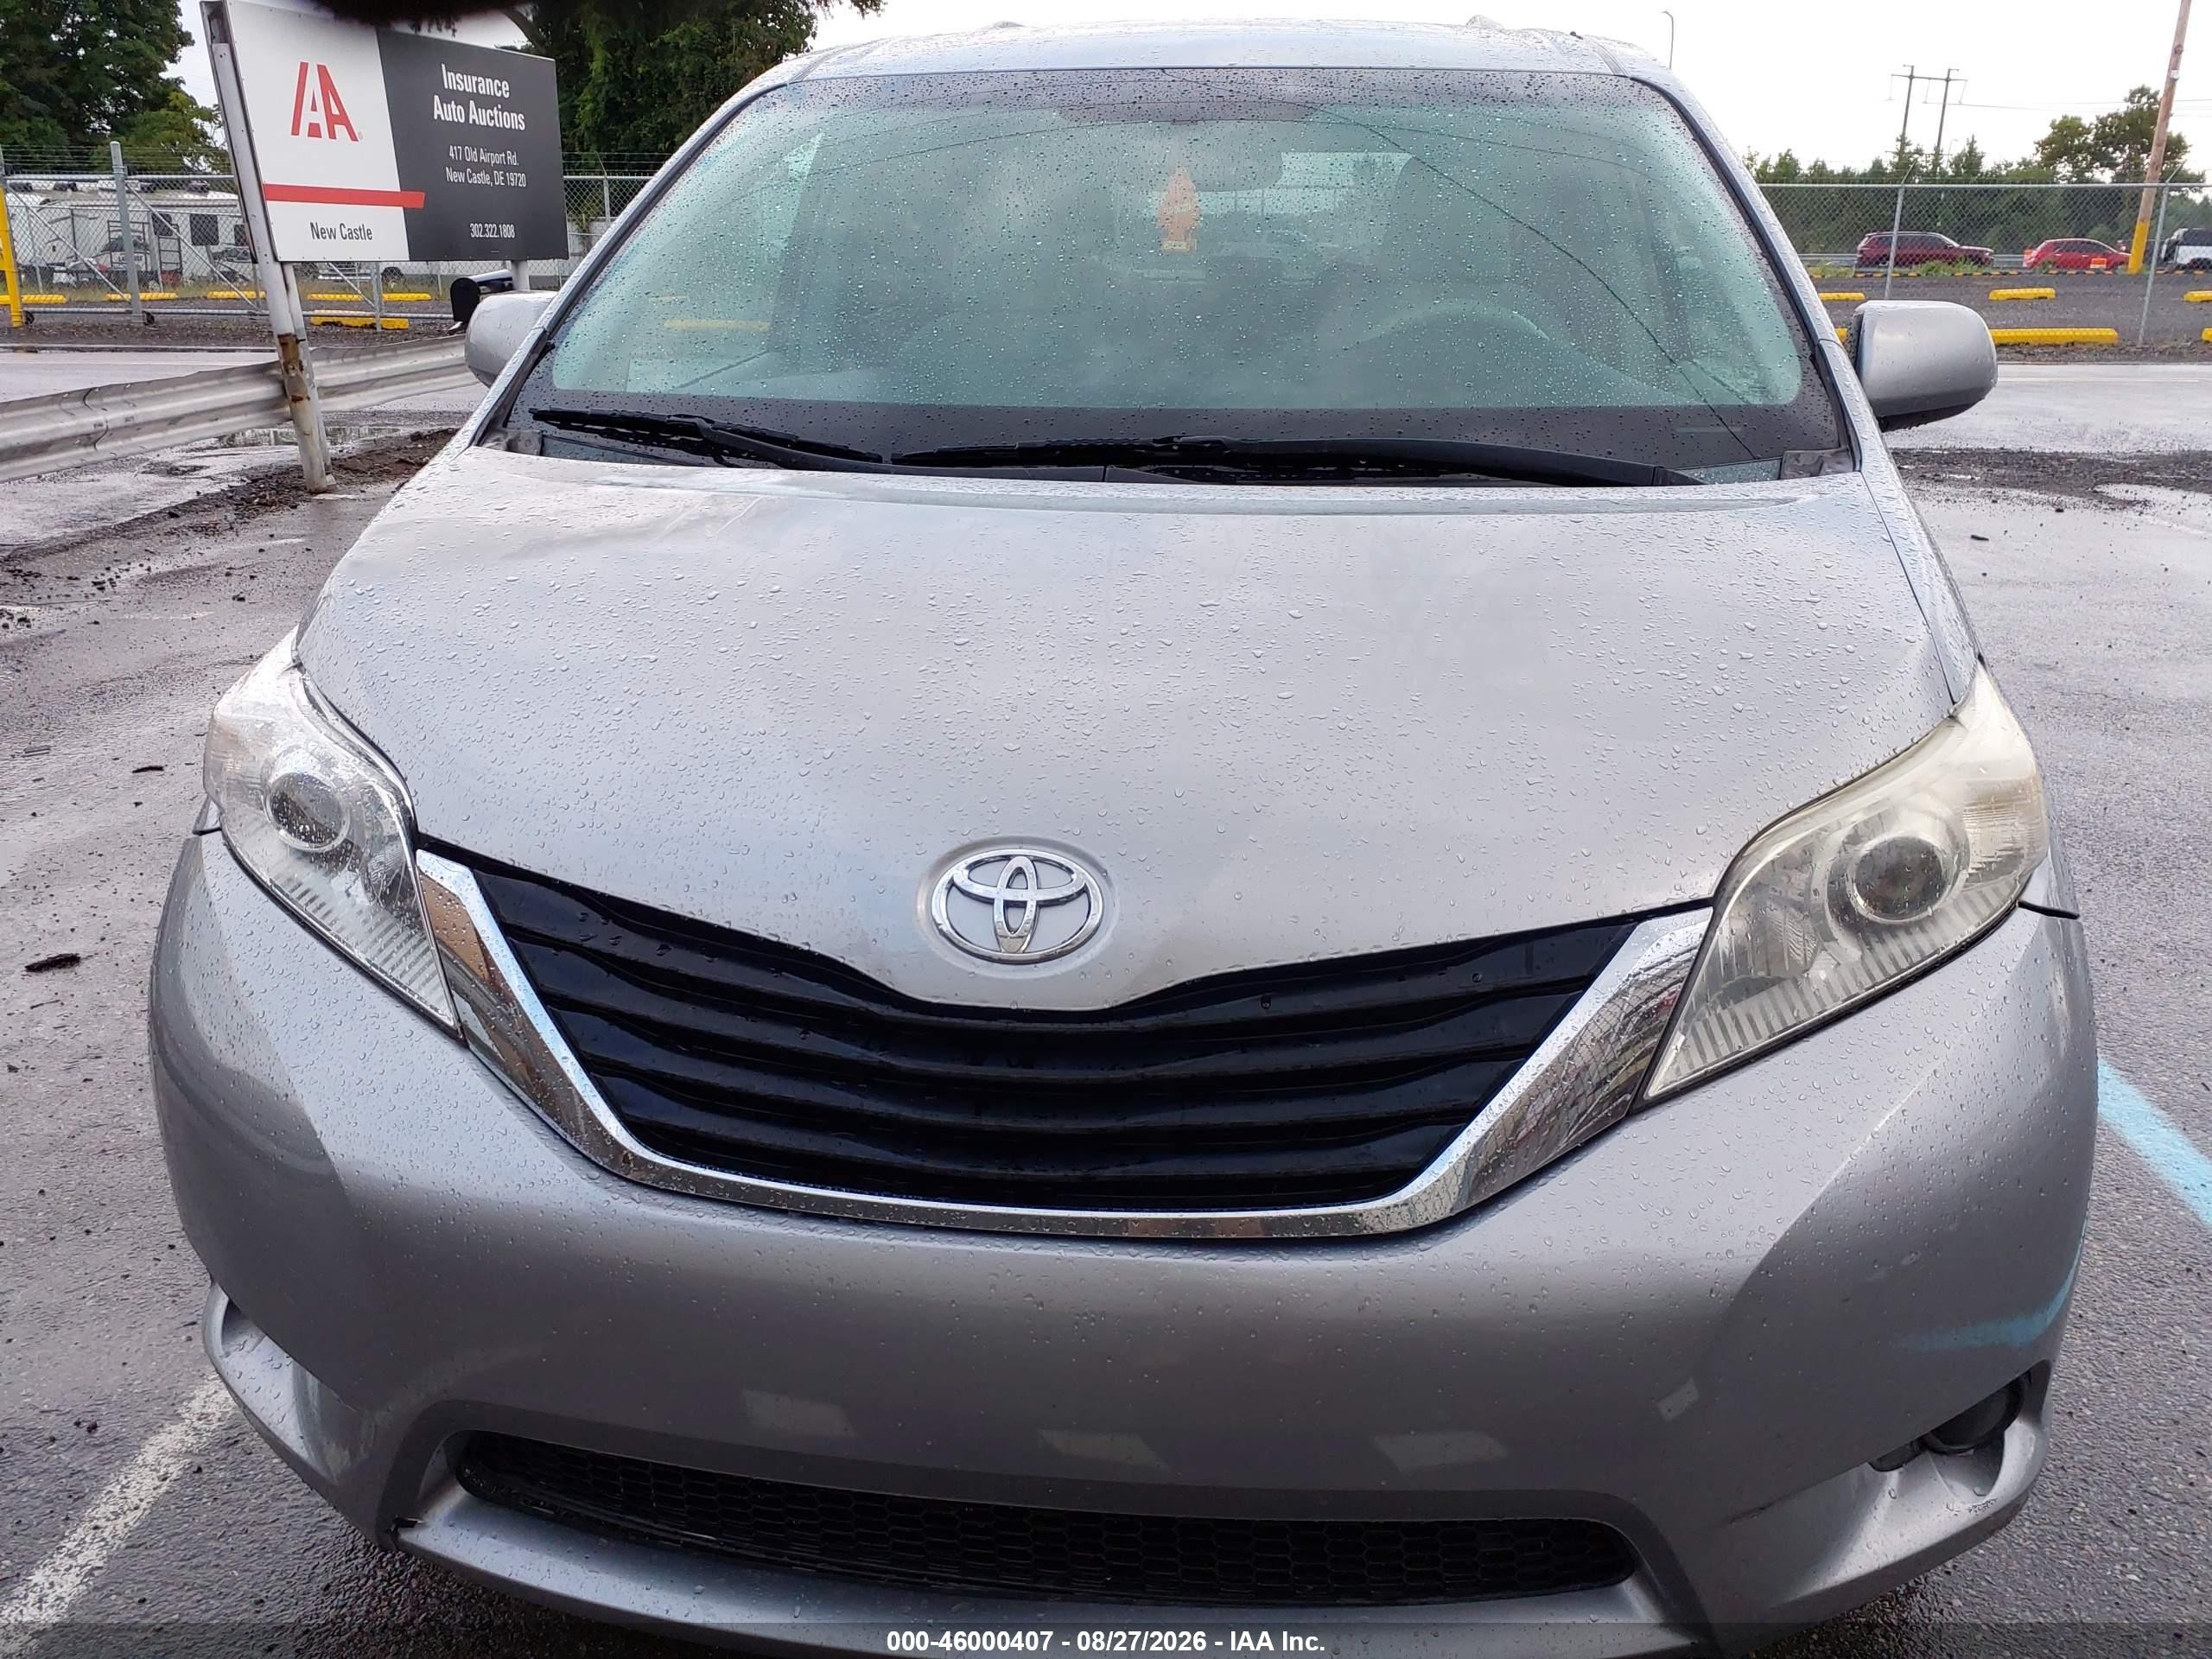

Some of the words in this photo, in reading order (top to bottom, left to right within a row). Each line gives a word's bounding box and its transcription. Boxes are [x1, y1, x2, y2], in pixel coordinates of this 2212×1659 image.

[441, 62, 510, 99] Insurance
[290, 61, 359, 142] IAA
[433, 93, 466, 124] Auto
[469, 99, 526, 131] Auctions
[448, 144, 462, 162] 417
[464, 145, 479, 163] Old
[480, 147, 506, 167] Airport
[506, 149, 520, 167] Rd.
[445, 165, 466, 183] New
[466, 168, 493, 188] Castle,
[493, 170, 505, 186] DE
[505, 171, 526, 188] 19720
[309, 221, 338, 240] New
[339, 222, 373, 241] Castle
[469, 222, 516, 238] 302.322.1808
